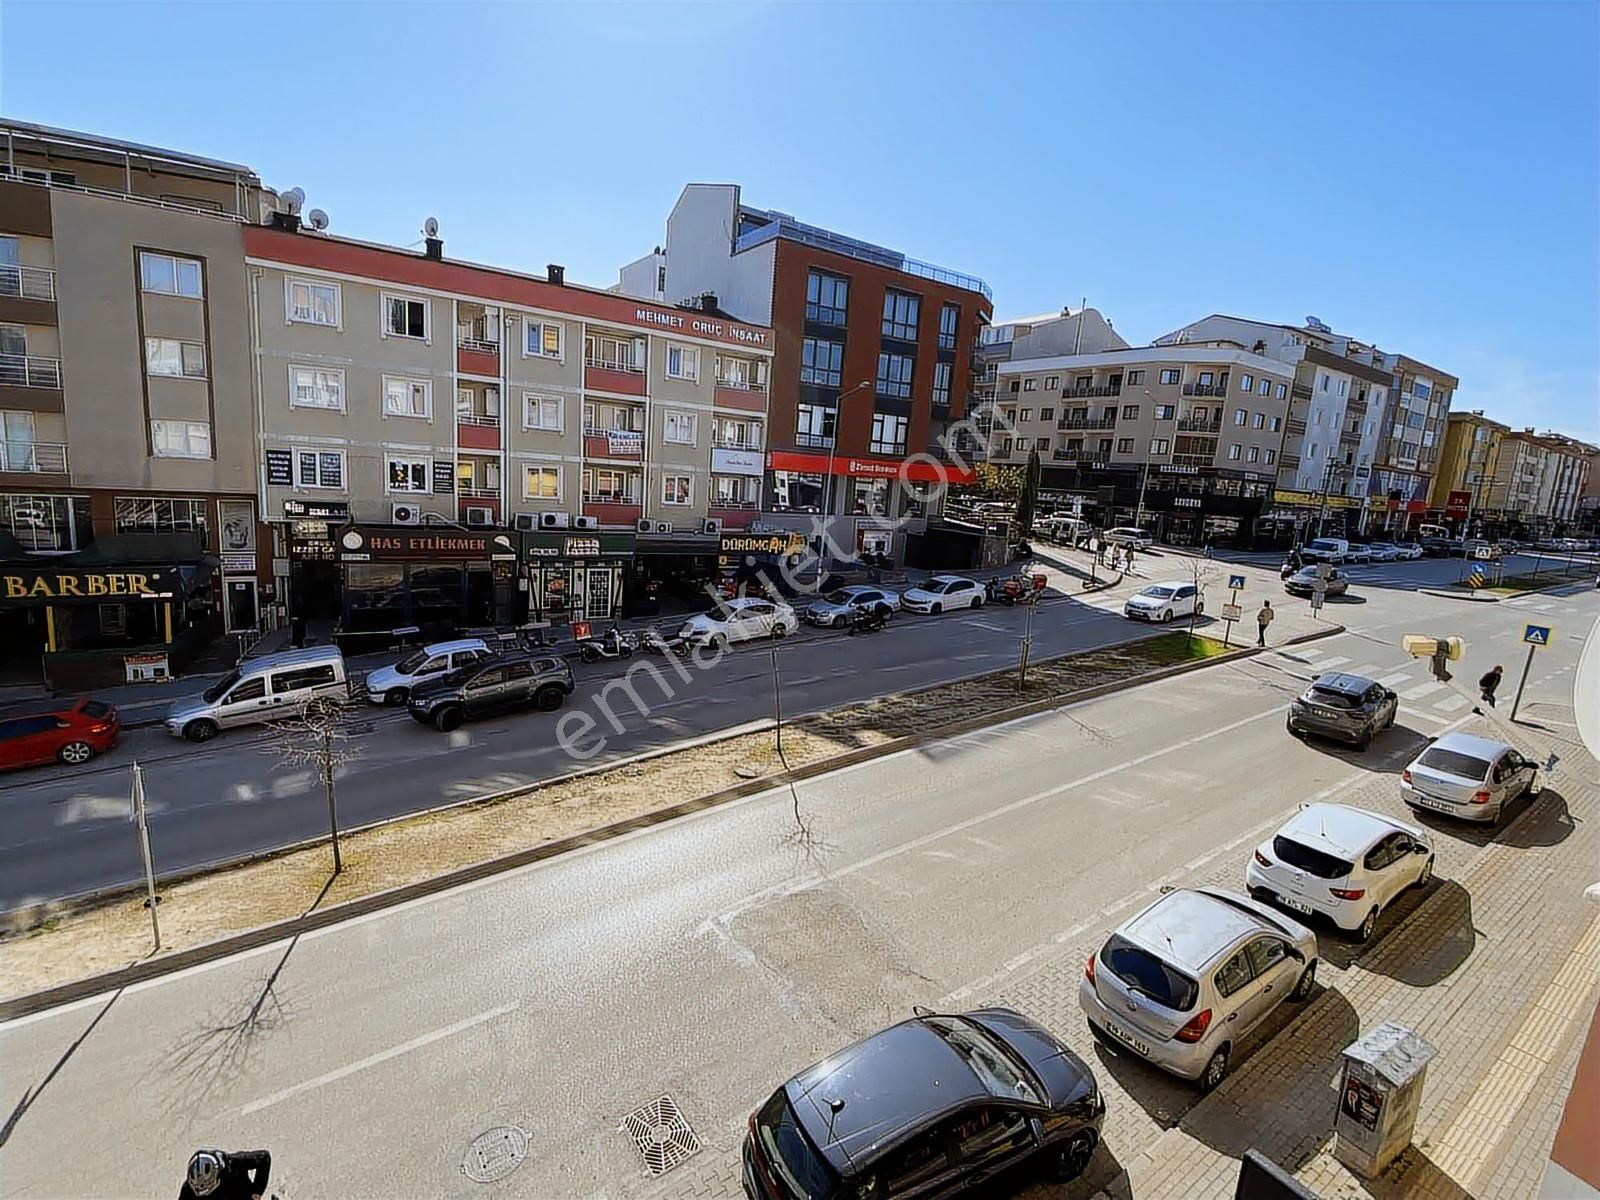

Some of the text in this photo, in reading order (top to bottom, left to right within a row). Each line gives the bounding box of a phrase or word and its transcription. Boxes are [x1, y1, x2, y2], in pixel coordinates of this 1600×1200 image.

[635, 309, 684, 328] MEHMET
[370, 535, 485, 550] HAS ETLİEKMEK
[3, 573, 155, 598] BARBER
